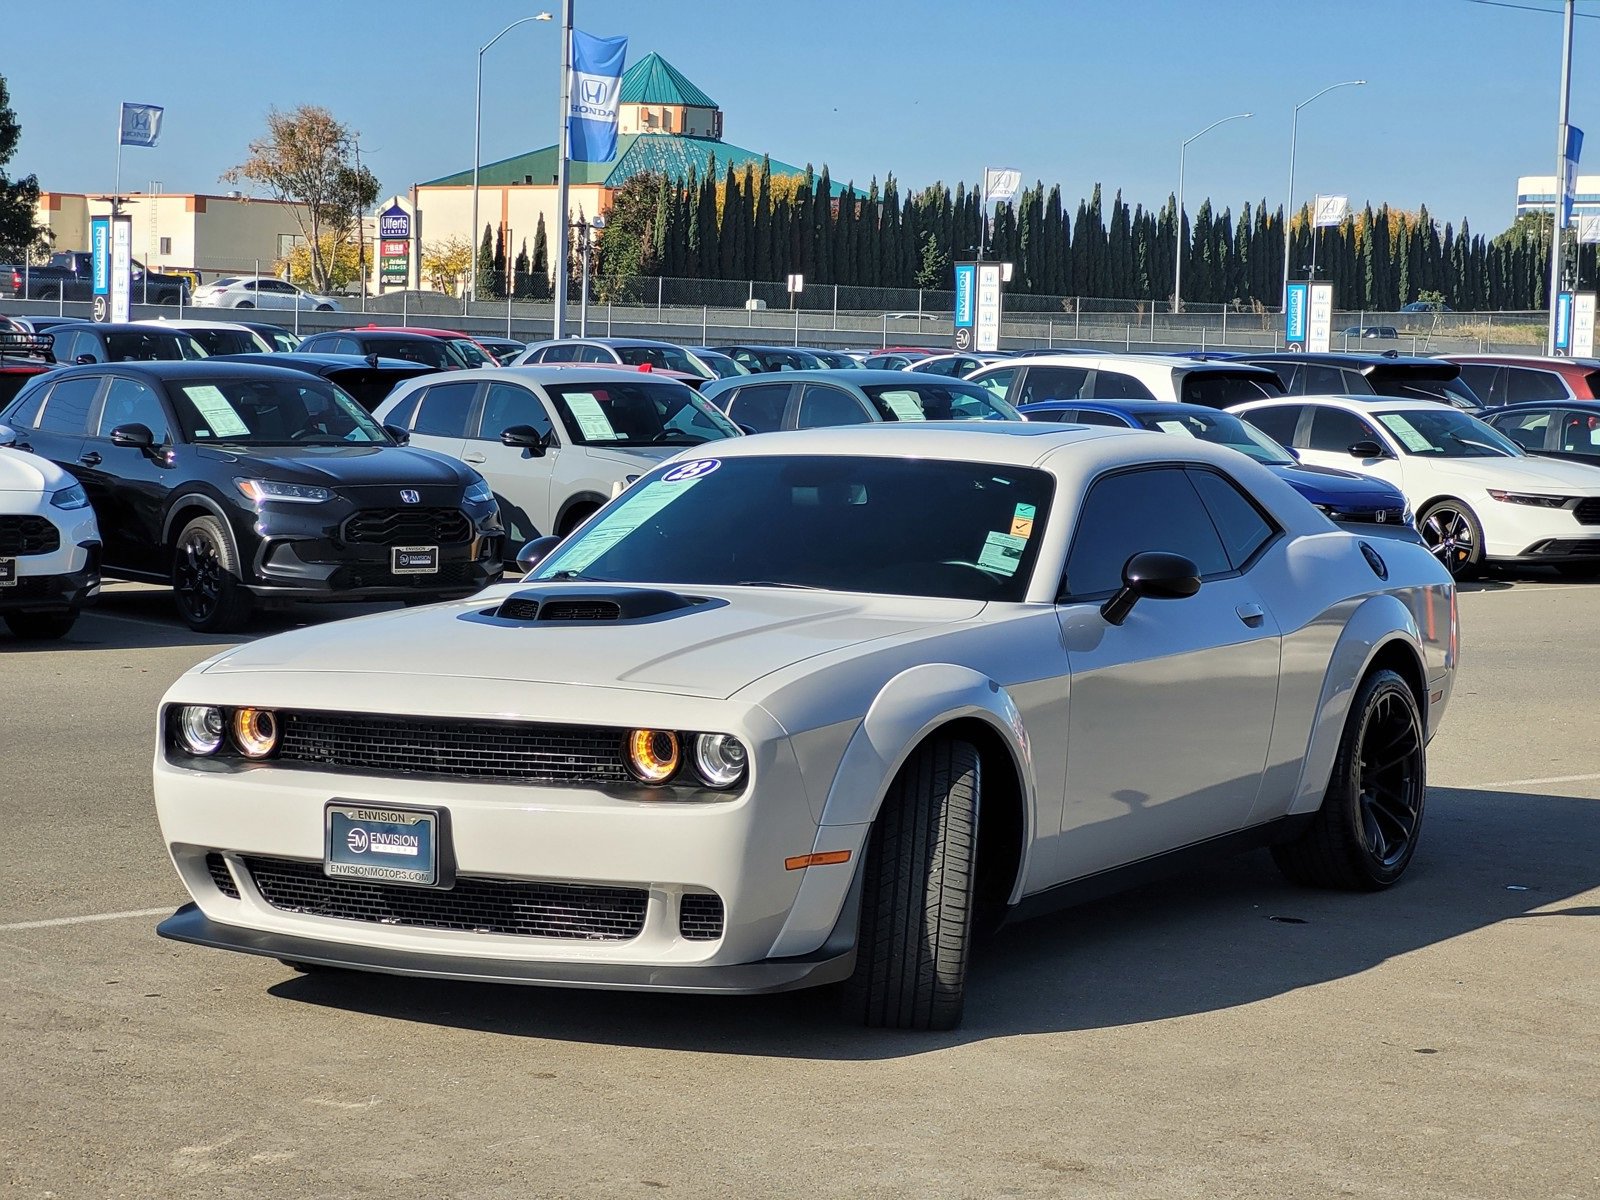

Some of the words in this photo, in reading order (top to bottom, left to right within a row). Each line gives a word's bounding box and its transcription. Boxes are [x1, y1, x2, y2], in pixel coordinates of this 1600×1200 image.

[571, 104, 617, 117] HONDA
[382, 218, 407, 229] Ulferts
[358, 810, 405, 823] ENVISION
[370, 832, 418, 847] ENVISION
